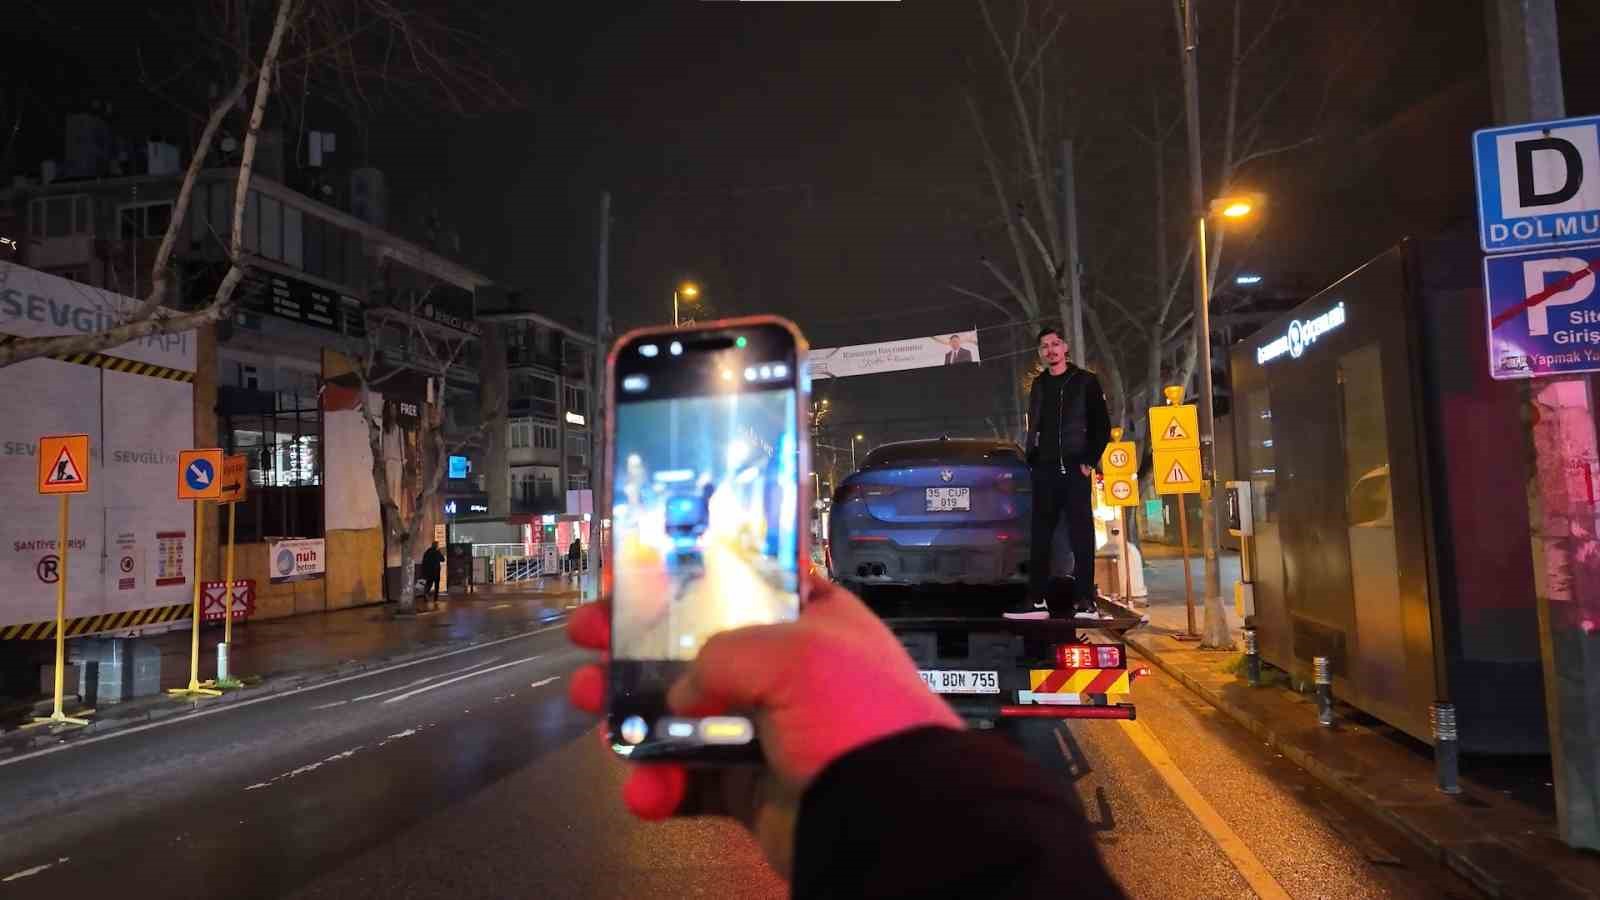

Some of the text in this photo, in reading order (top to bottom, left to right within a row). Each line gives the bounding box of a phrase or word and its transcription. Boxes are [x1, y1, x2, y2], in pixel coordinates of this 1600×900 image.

[1514, 137, 1584, 208] D
[1112, 453, 1126, 464] 30
[927, 488, 968, 497] 35 CUP
[296, 550, 317, 562] nuh
[972, 673, 995, 687] 755
